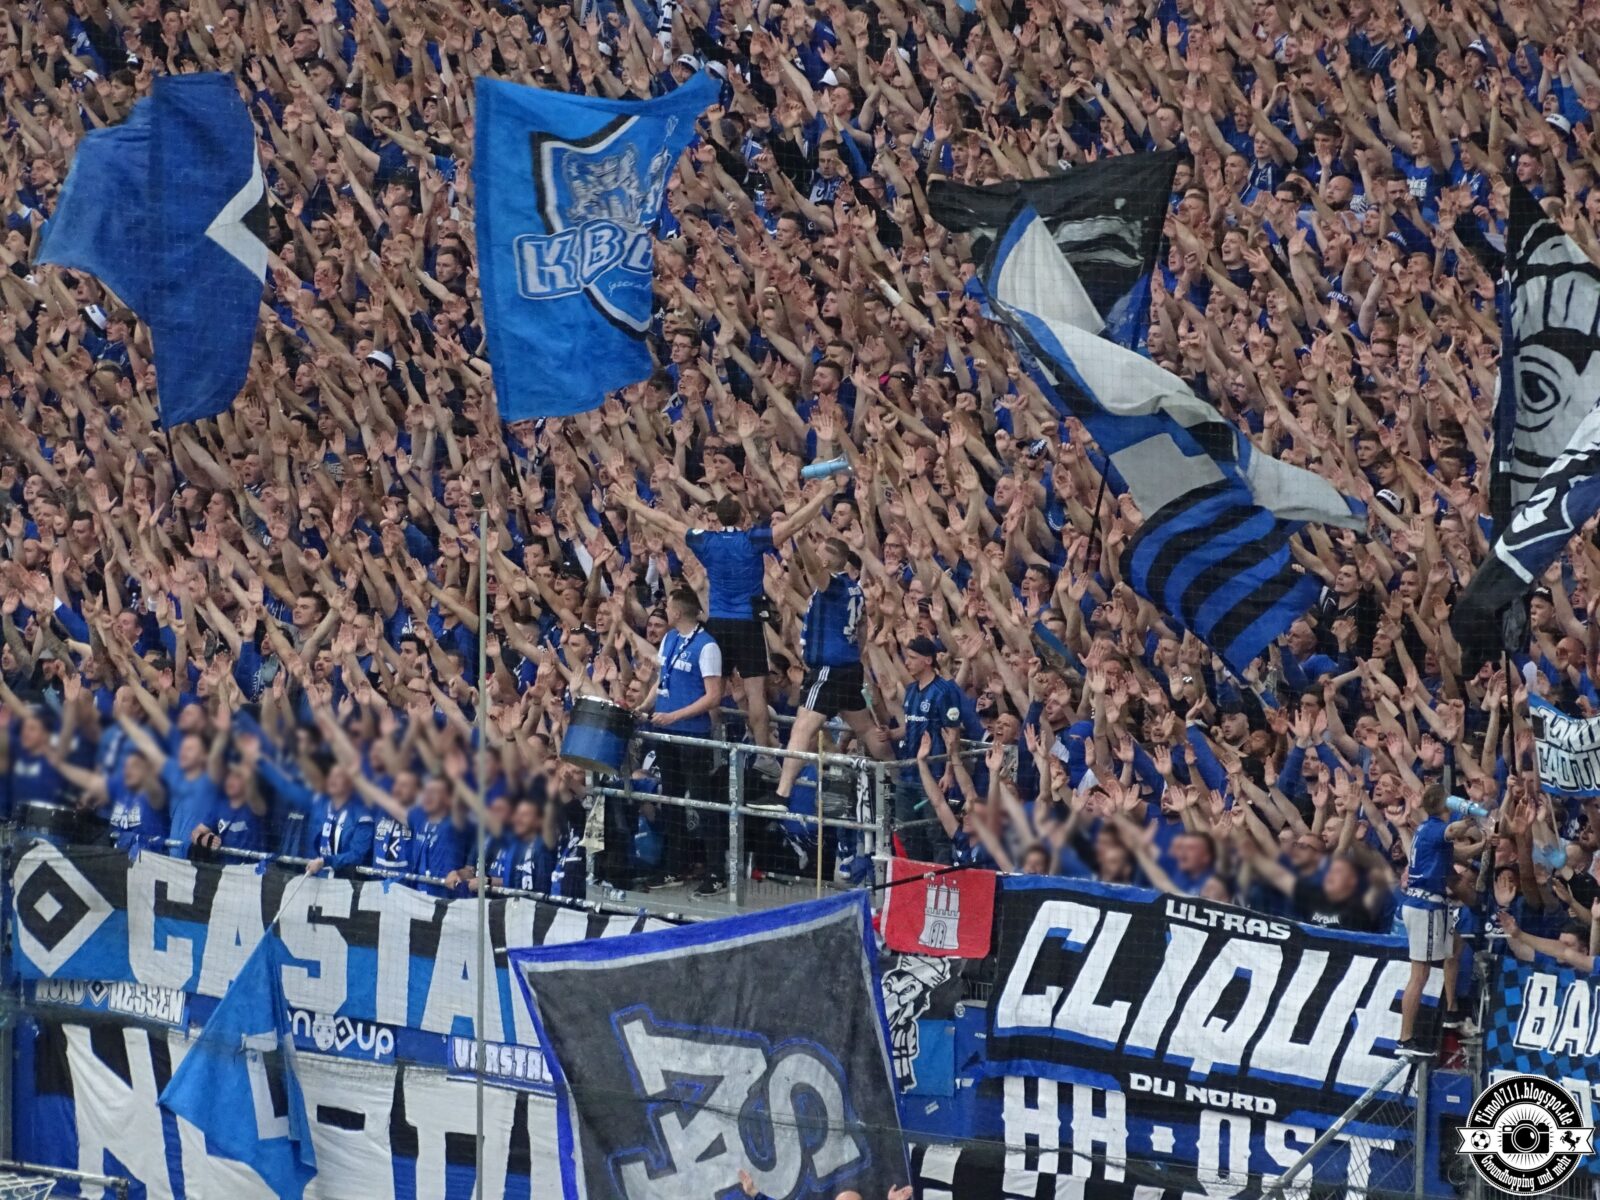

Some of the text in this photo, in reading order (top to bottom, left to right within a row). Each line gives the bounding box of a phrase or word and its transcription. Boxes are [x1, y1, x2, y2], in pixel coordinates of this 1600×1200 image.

[1166, 899, 1291, 941] ULTRAS
[997, 900, 1443, 1096] CLIQUE
[1130, 1072, 1277, 1115] DU NORD
